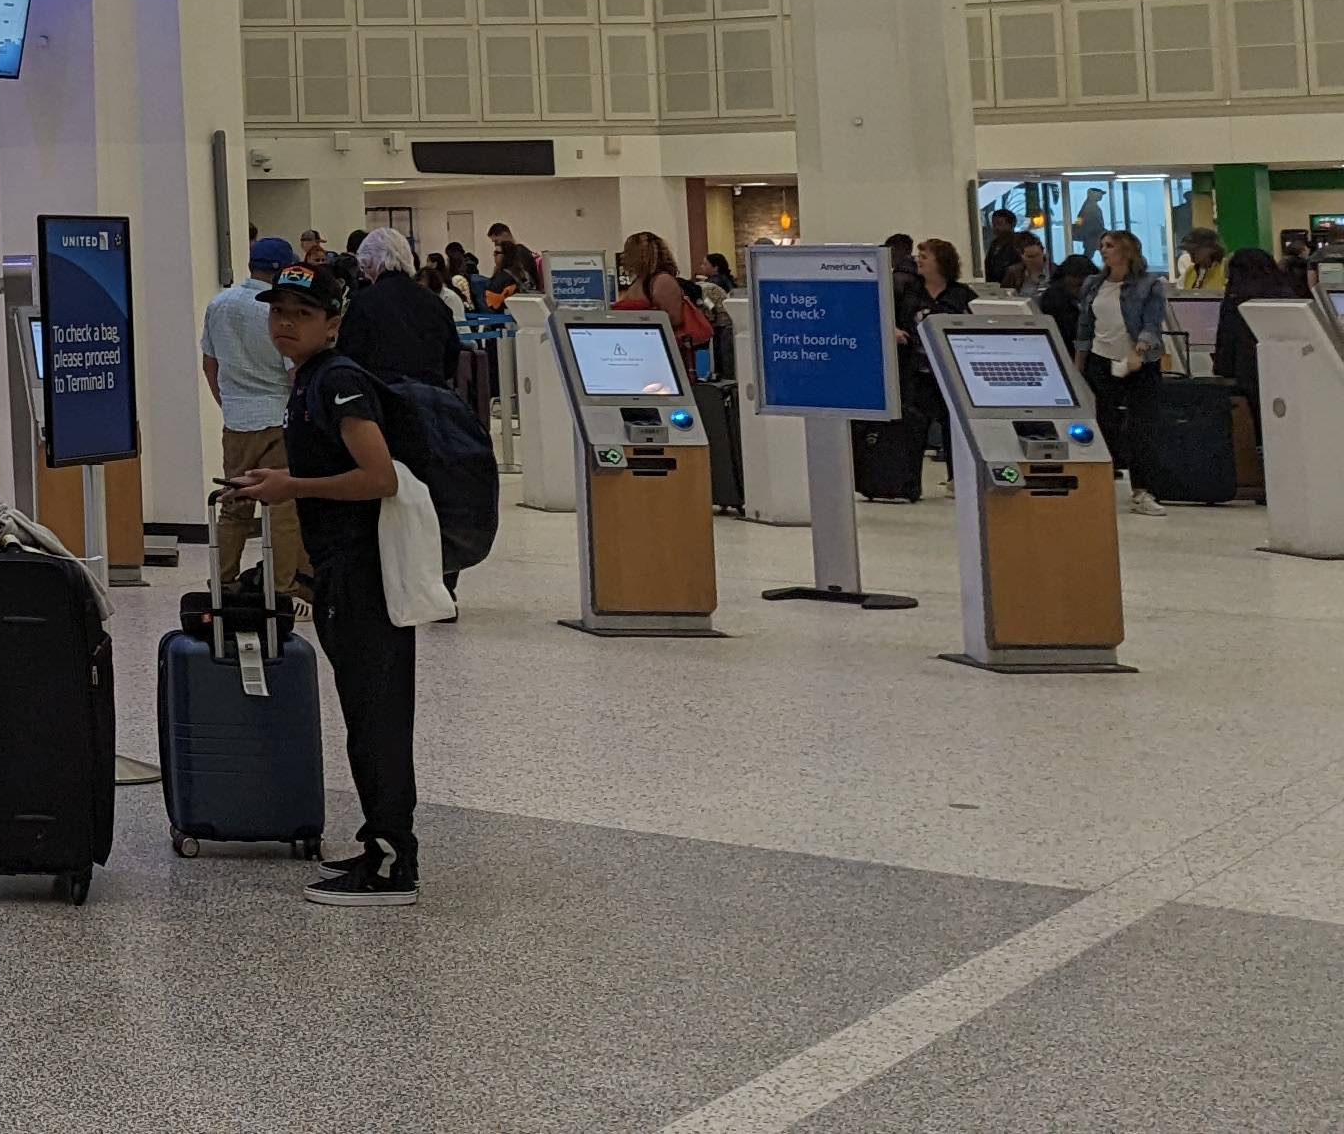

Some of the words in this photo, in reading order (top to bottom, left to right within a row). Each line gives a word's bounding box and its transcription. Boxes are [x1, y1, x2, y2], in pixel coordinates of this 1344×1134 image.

[62, 235, 97, 248] UNITED
[821, 263, 860, 271] American
[573, 277, 590, 286] your
[770, 294, 787, 304] No
[791, 294, 818, 307] bags
[771, 310, 783, 319] to
[786, 309, 826, 320] check?
[52, 325, 64, 343] To
[66, 326, 92, 342] check
[94, 327, 99, 341] a
[773, 334, 800, 344] Print
[803, 334, 857, 349] boarding
[54, 351, 83, 370] please
[85, 347, 120, 367] proceed
[774, 350, 798, 361] pass
[801, 349, 831, 360] here.
[55, 377, 64, 393] to
[66, 372, 105, 393] Terminal
[108, 372, 114, 389] B
